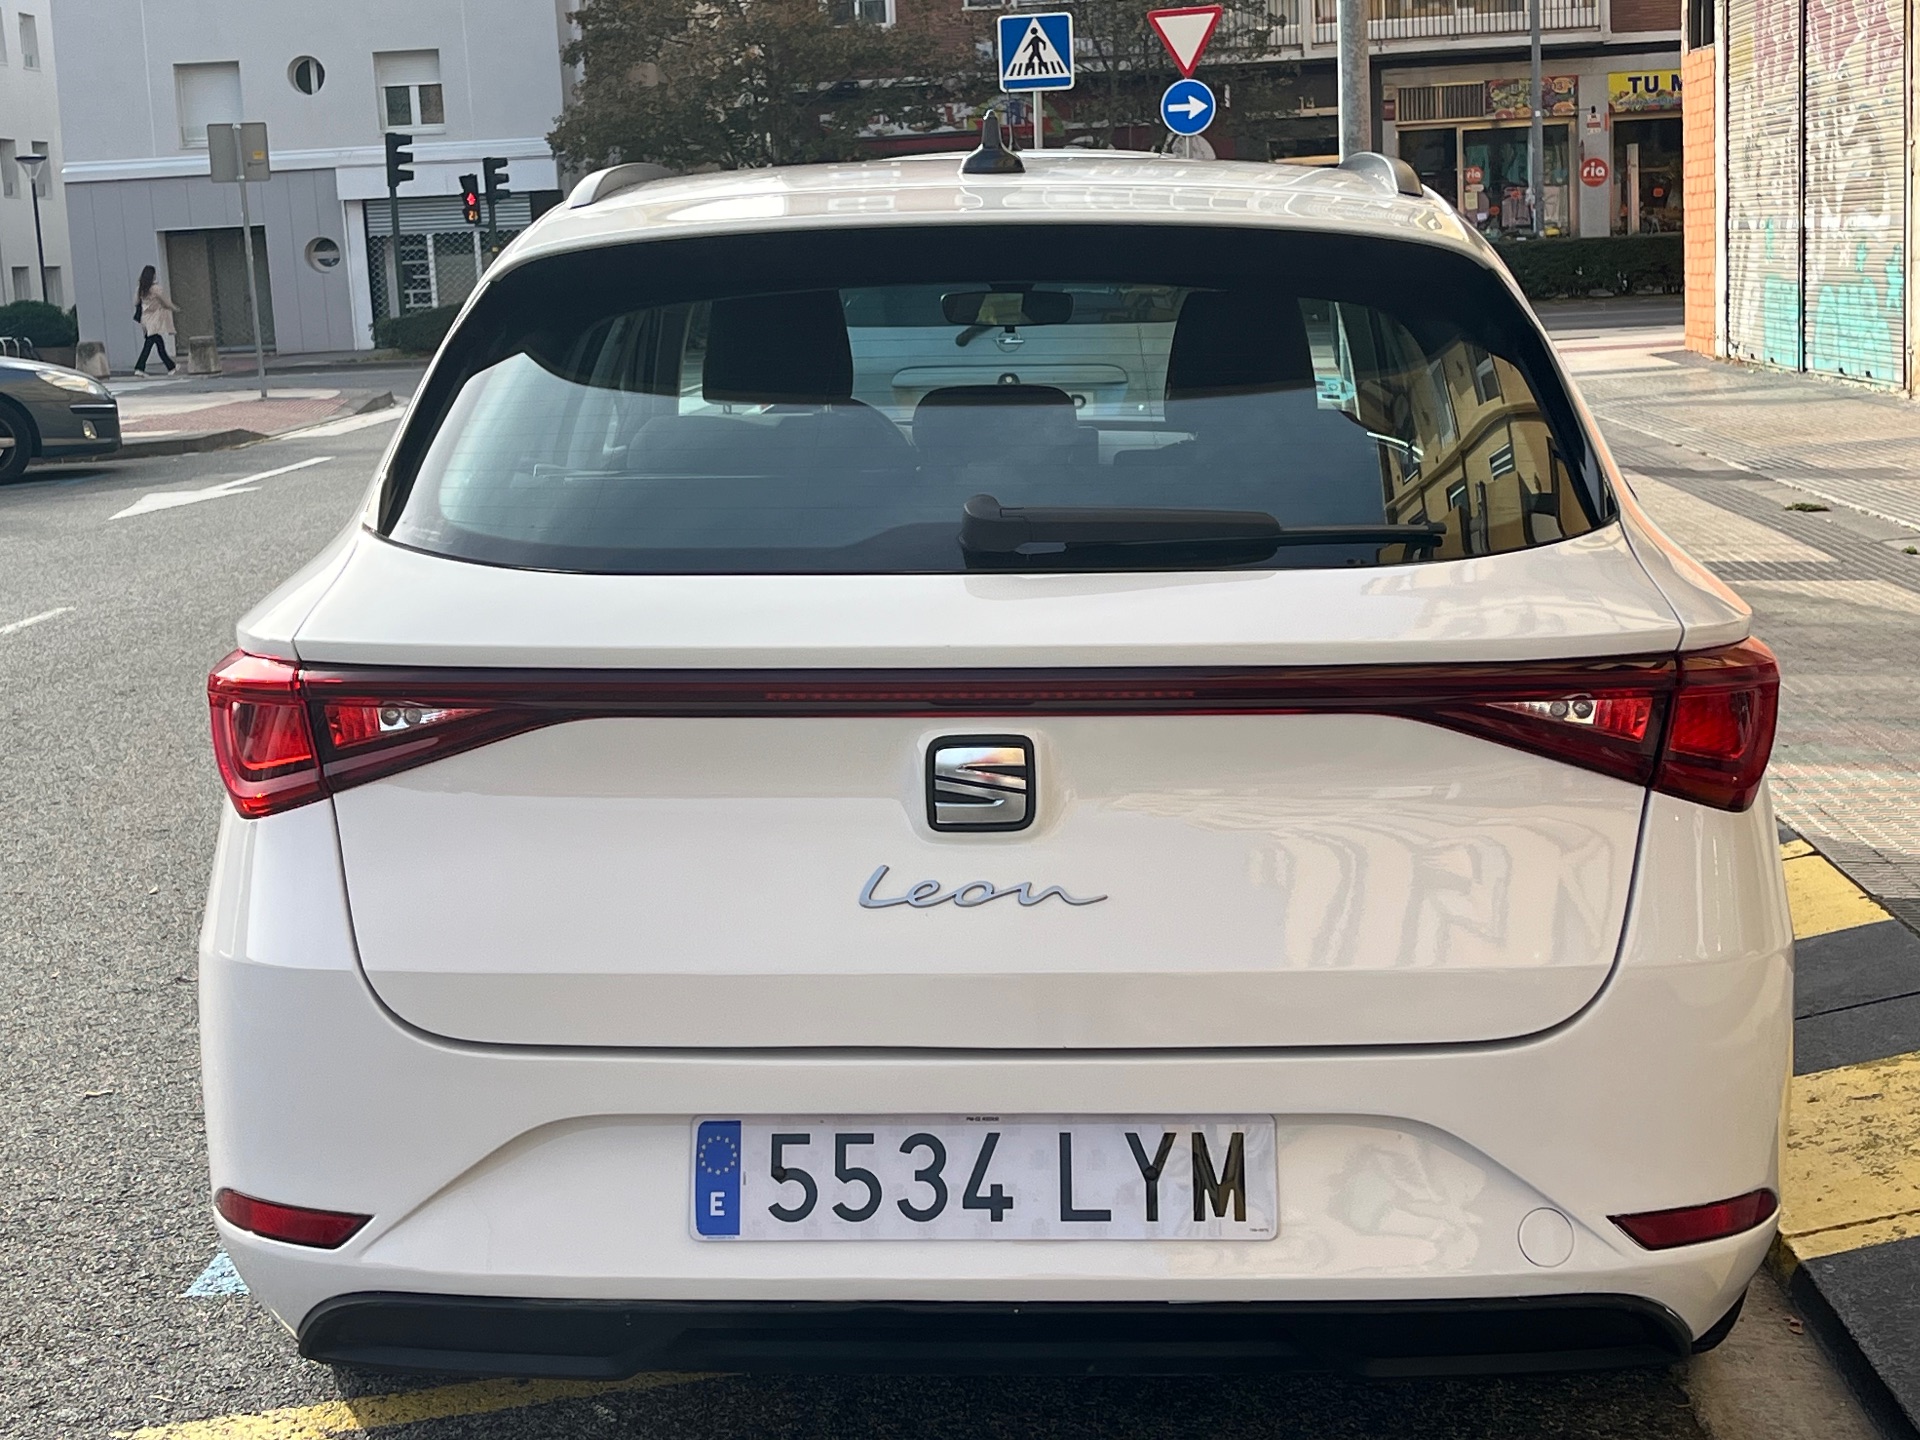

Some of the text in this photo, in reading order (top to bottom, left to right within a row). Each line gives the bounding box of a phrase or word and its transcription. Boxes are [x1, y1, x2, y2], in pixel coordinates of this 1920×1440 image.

[1627, 75, 1659, 94] TU
[1583, 161, 1606, 177] ria
[859, 864, 1108, 909] Leon
[769, 1132, 1246, 1222] 5534 LYM
[711, 1192, 724, 1215] E
